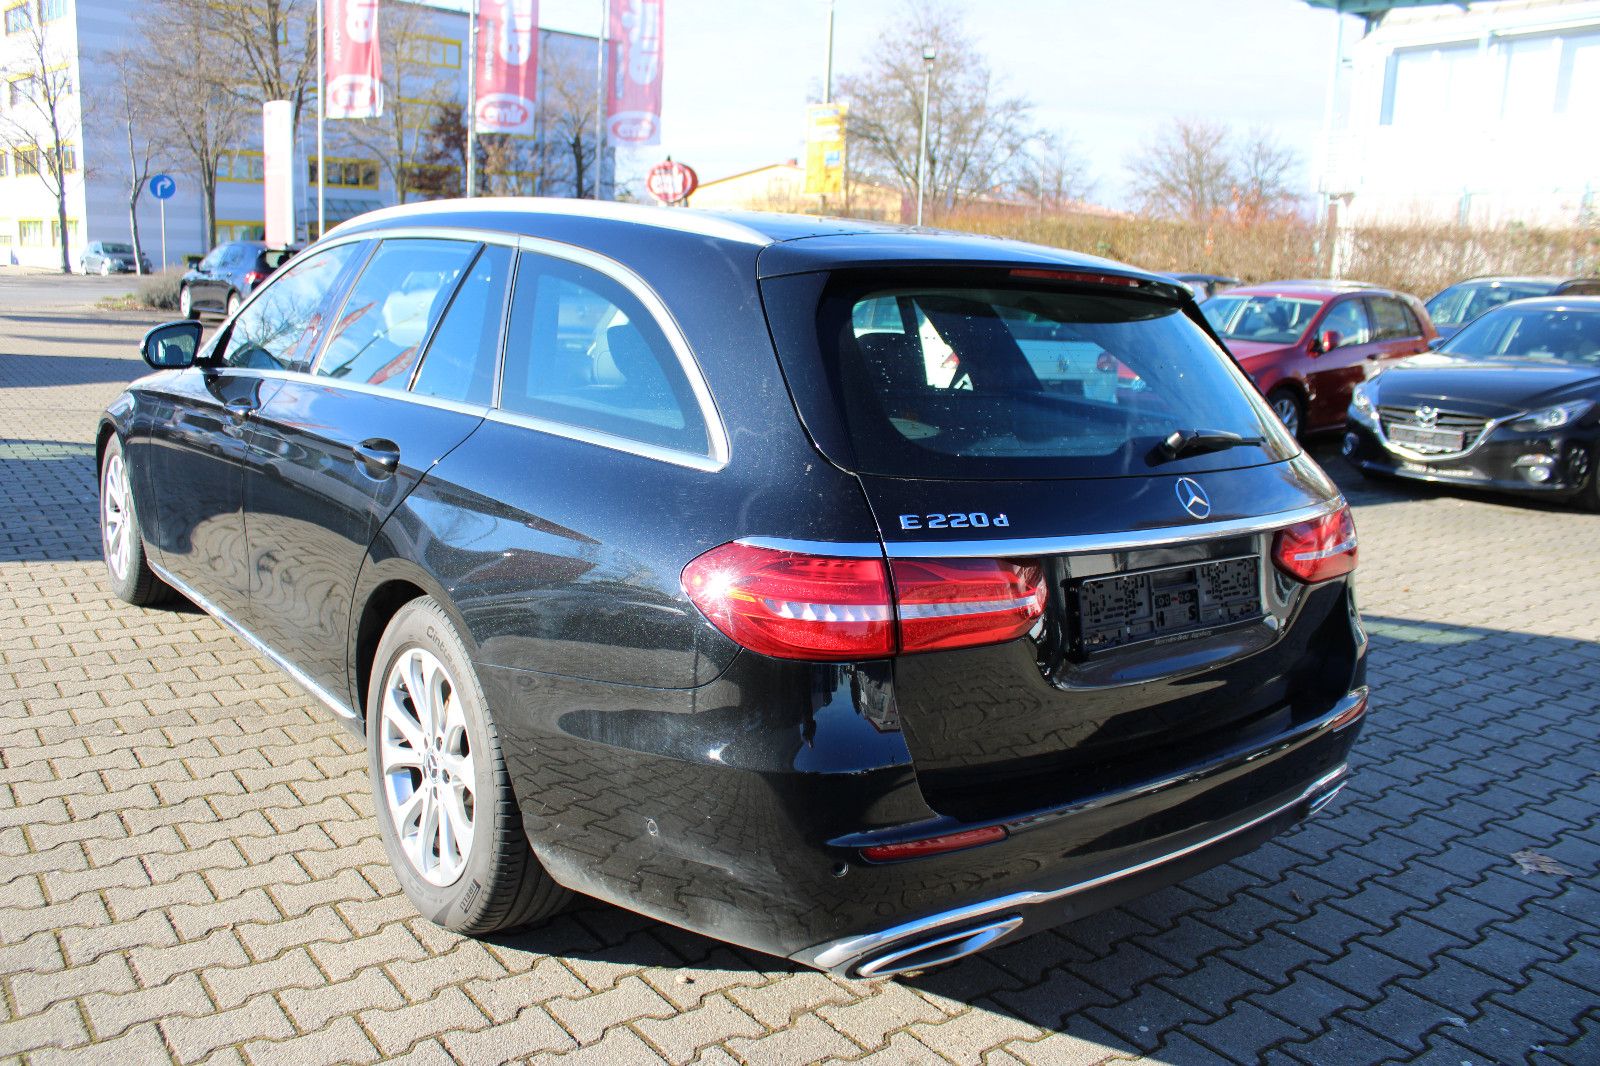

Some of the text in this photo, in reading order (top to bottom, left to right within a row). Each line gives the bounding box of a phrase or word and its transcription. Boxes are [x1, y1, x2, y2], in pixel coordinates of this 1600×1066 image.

[485, 104, 525, 122] emir
[899, 512, 1010, 530] E 220 d
[455, 878, 481, 914] PIRELLI
